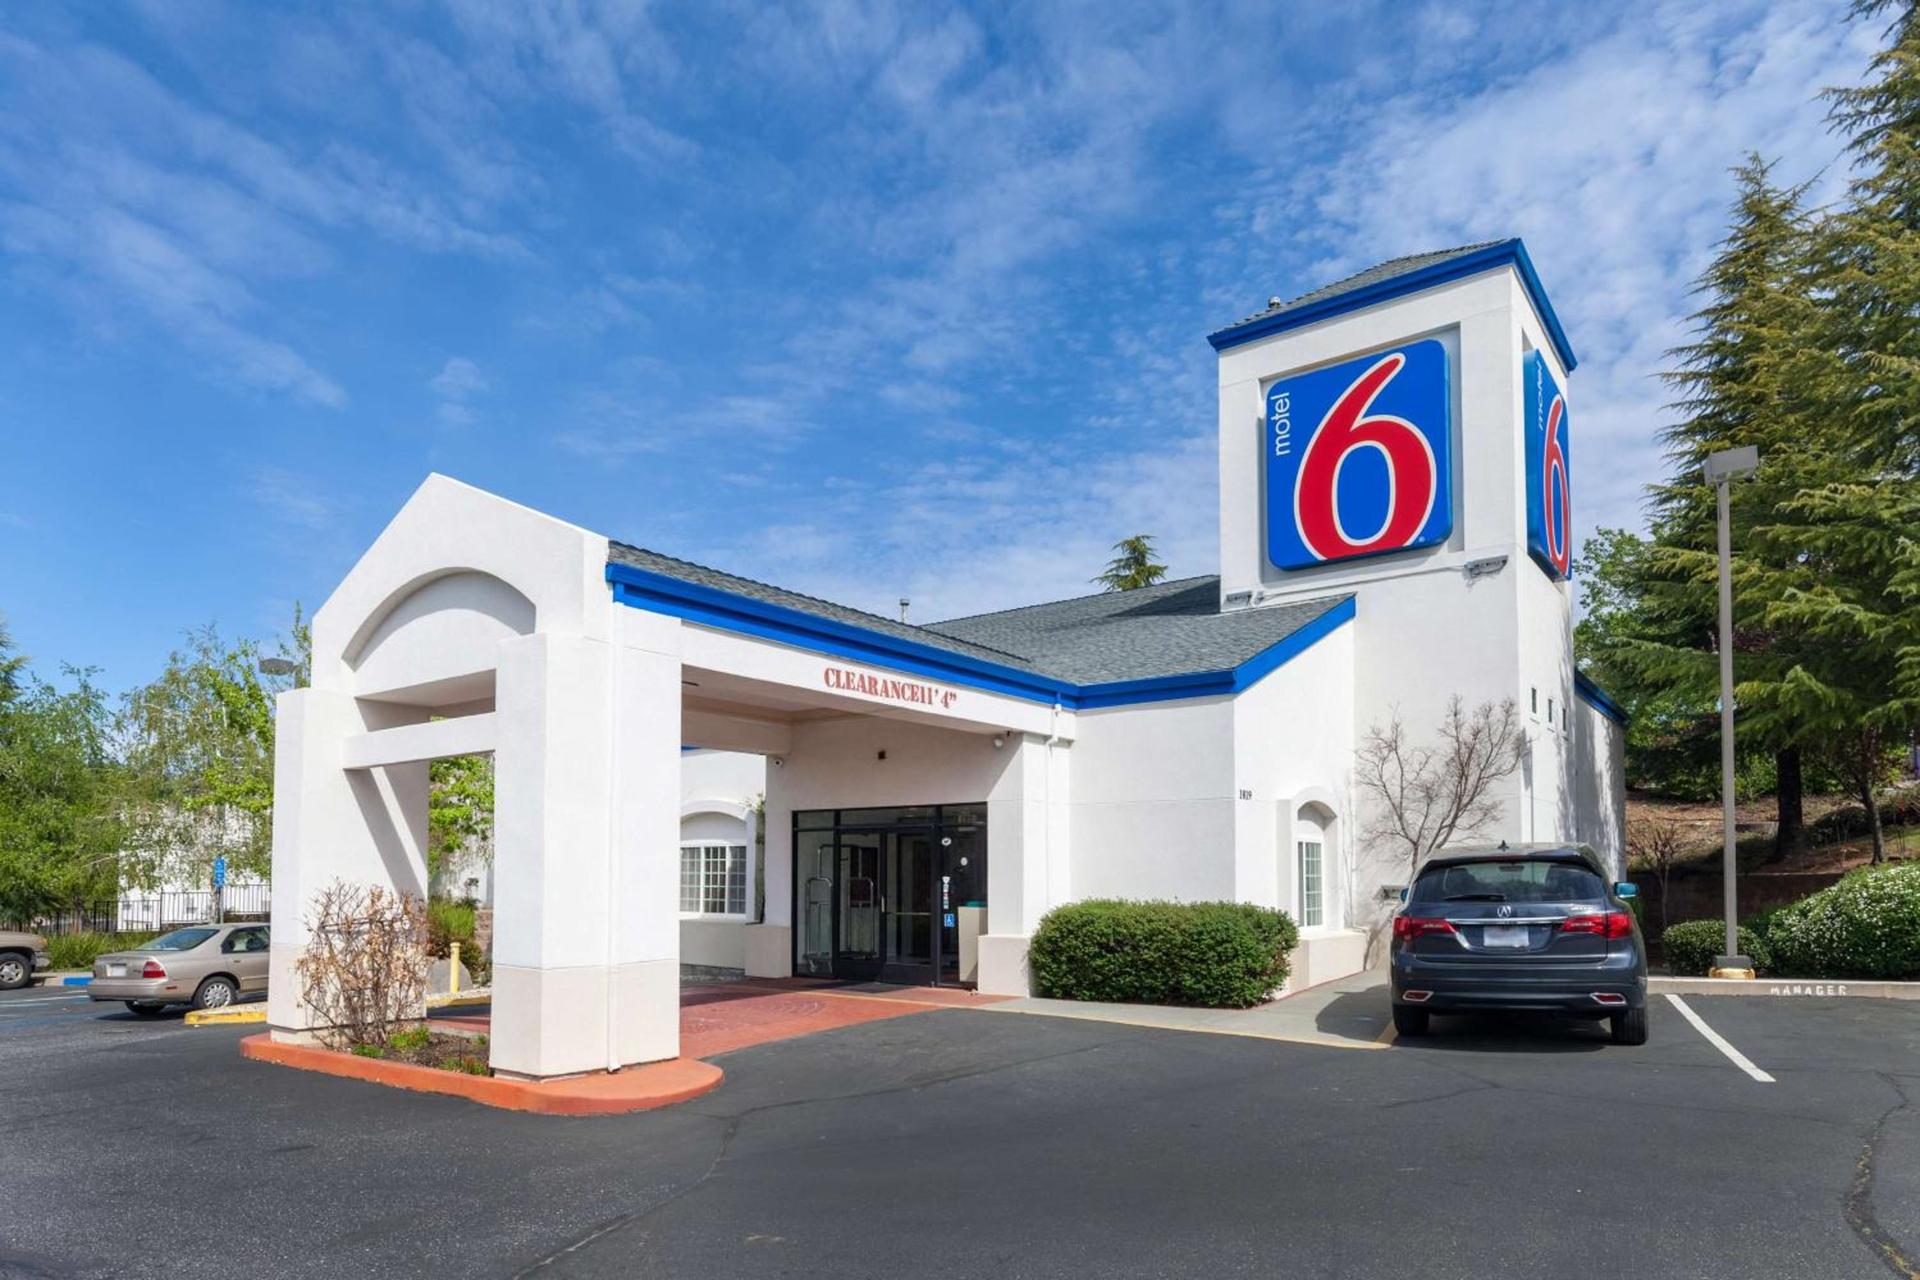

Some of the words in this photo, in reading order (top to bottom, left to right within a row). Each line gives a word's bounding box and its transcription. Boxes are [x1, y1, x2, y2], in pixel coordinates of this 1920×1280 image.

[1270, 392, 1290, 456] motel
[1294, 352, 1437, 560] 6
[1543, 393, 1569, 576] 6
[1770, 985, 1847, 996] MANAGER
